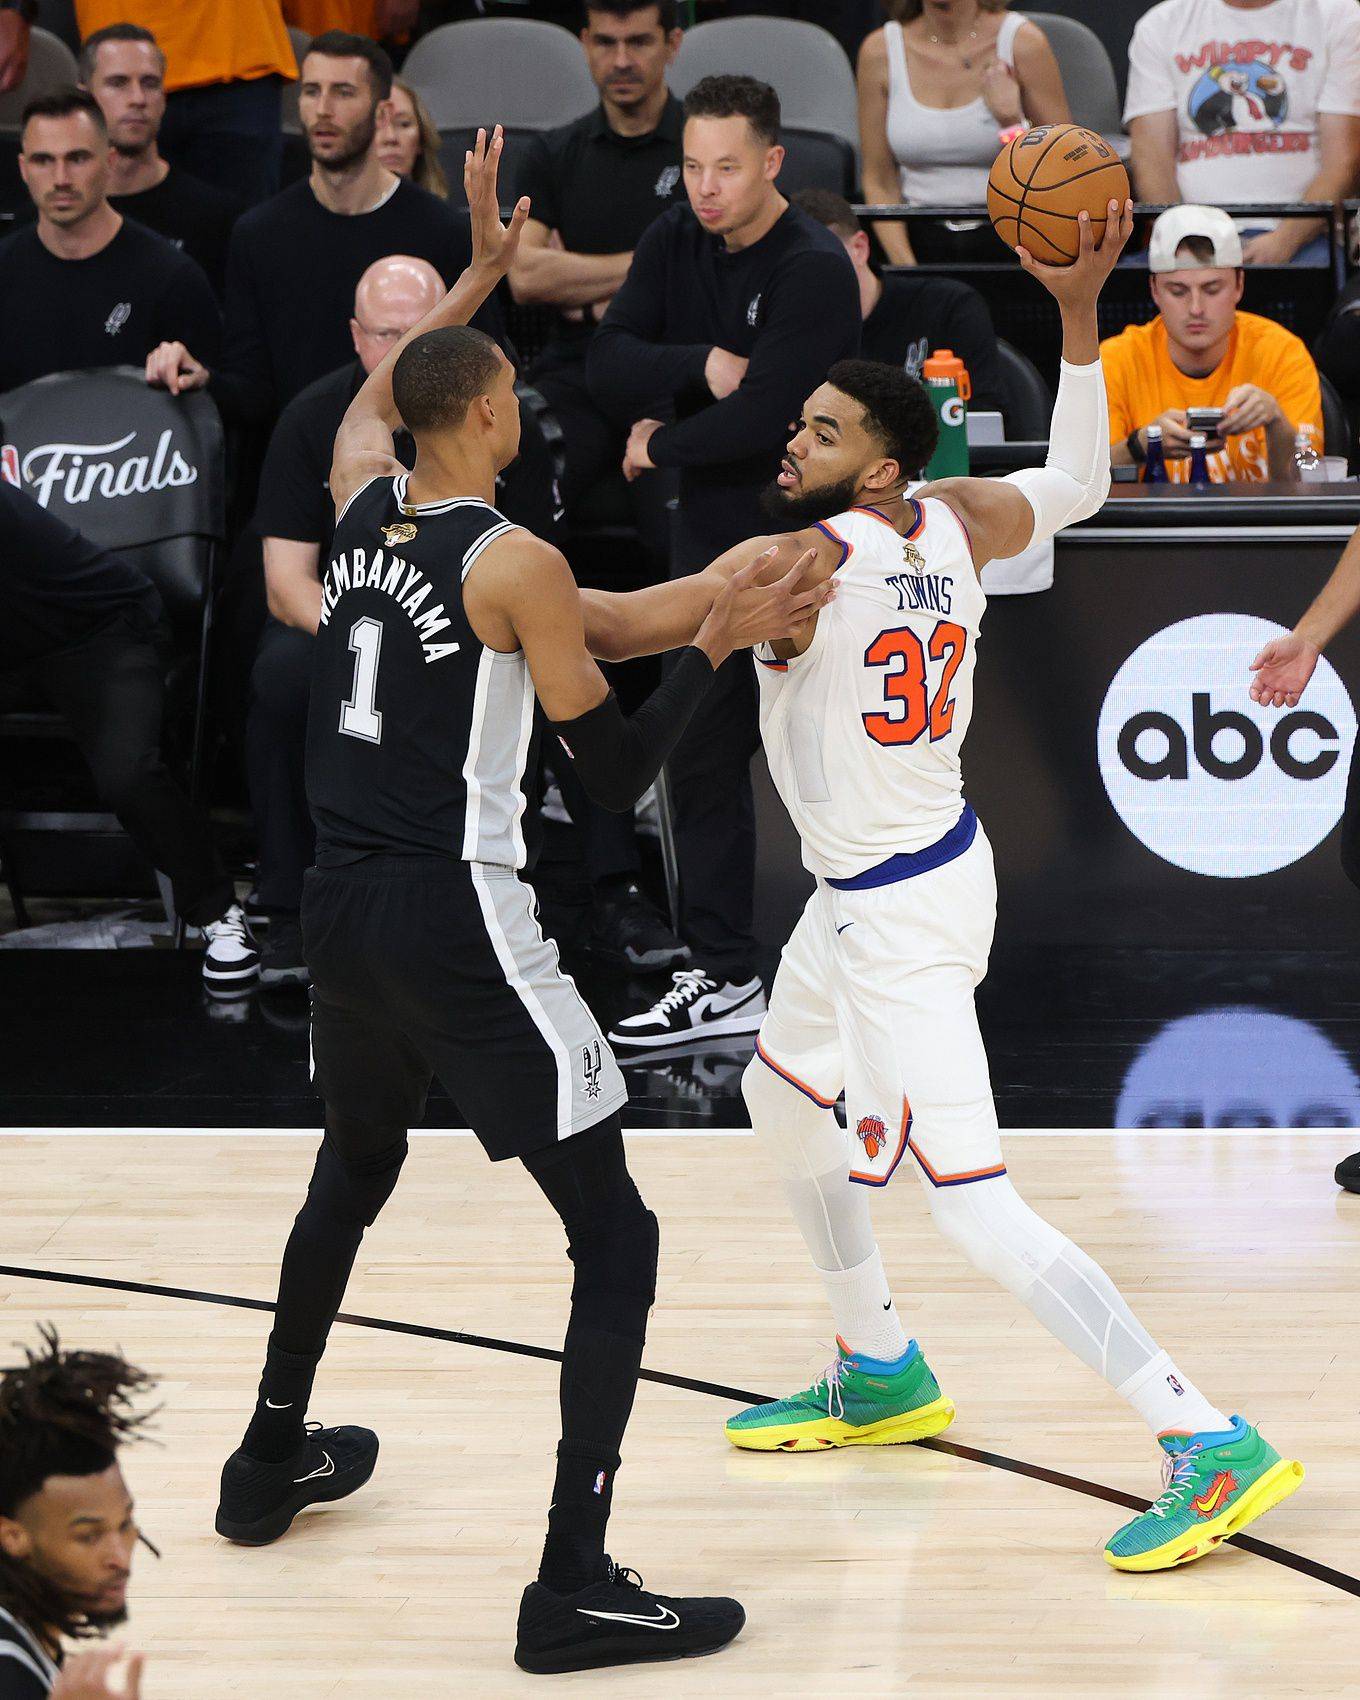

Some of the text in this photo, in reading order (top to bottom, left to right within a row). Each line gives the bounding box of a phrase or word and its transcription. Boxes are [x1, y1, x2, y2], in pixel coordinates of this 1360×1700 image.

[941, 396, 964, 427] G
[22, 429, 198, 509] Finals
[885, 573, 954, 615] TOWNS
[338, 615, 384, 745] 1
[862, 620, 967, 747] 32
[1117, 692, 1340, 781] abc
